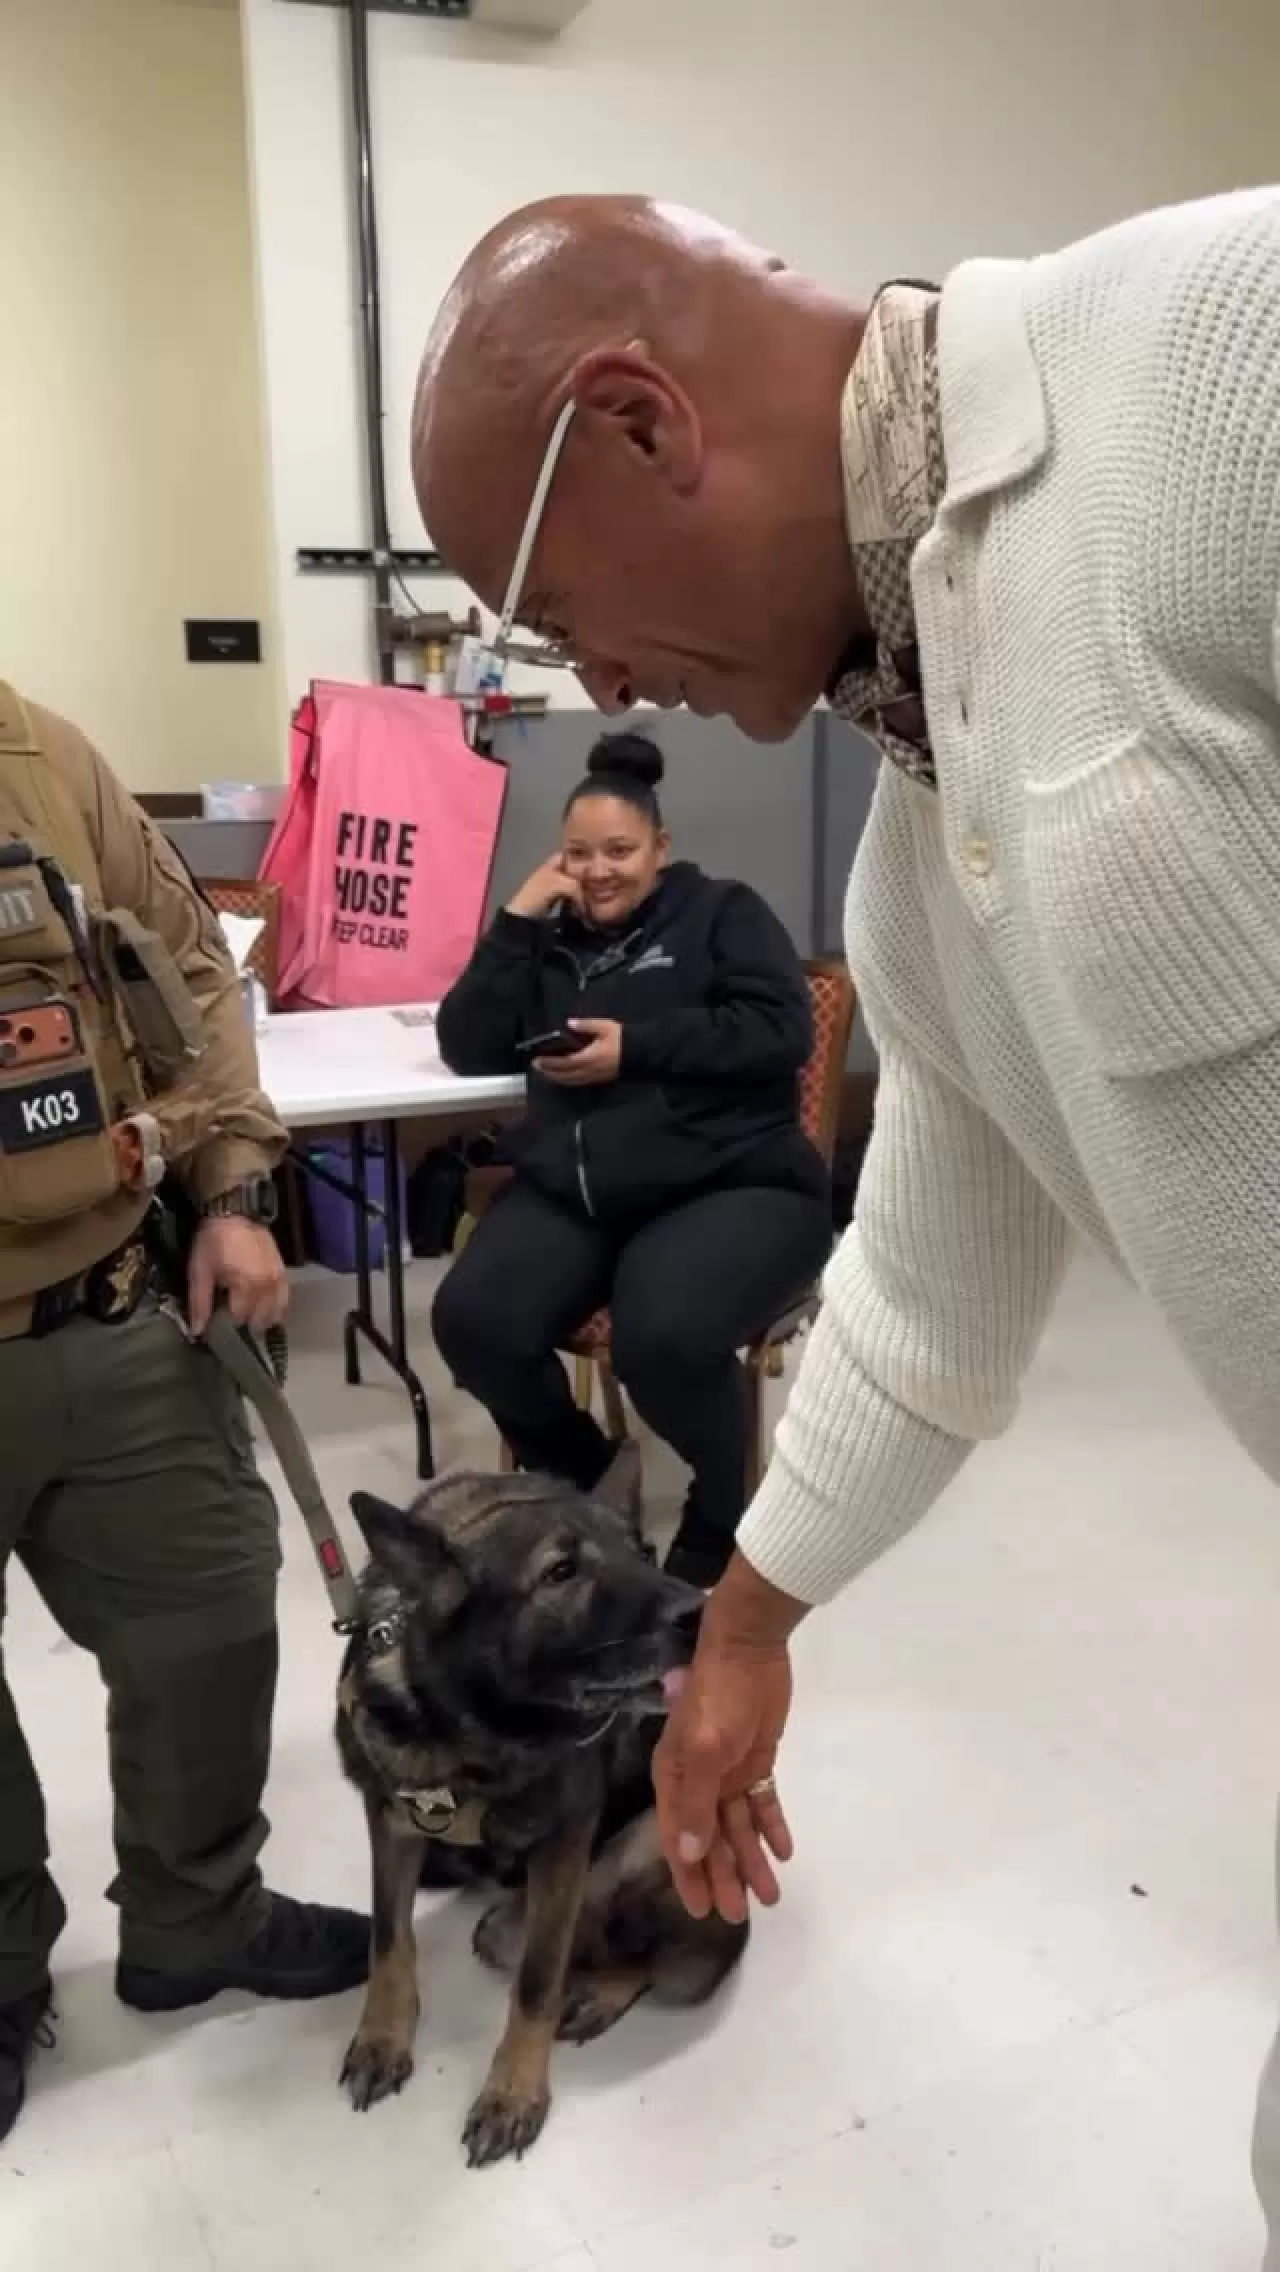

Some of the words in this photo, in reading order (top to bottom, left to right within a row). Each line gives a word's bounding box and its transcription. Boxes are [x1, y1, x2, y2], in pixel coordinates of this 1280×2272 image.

[336, 811, 419, 868] FIRE
[359, 923, 409, 952] CLEAR
[20, 1090, 80, 1133] K03
